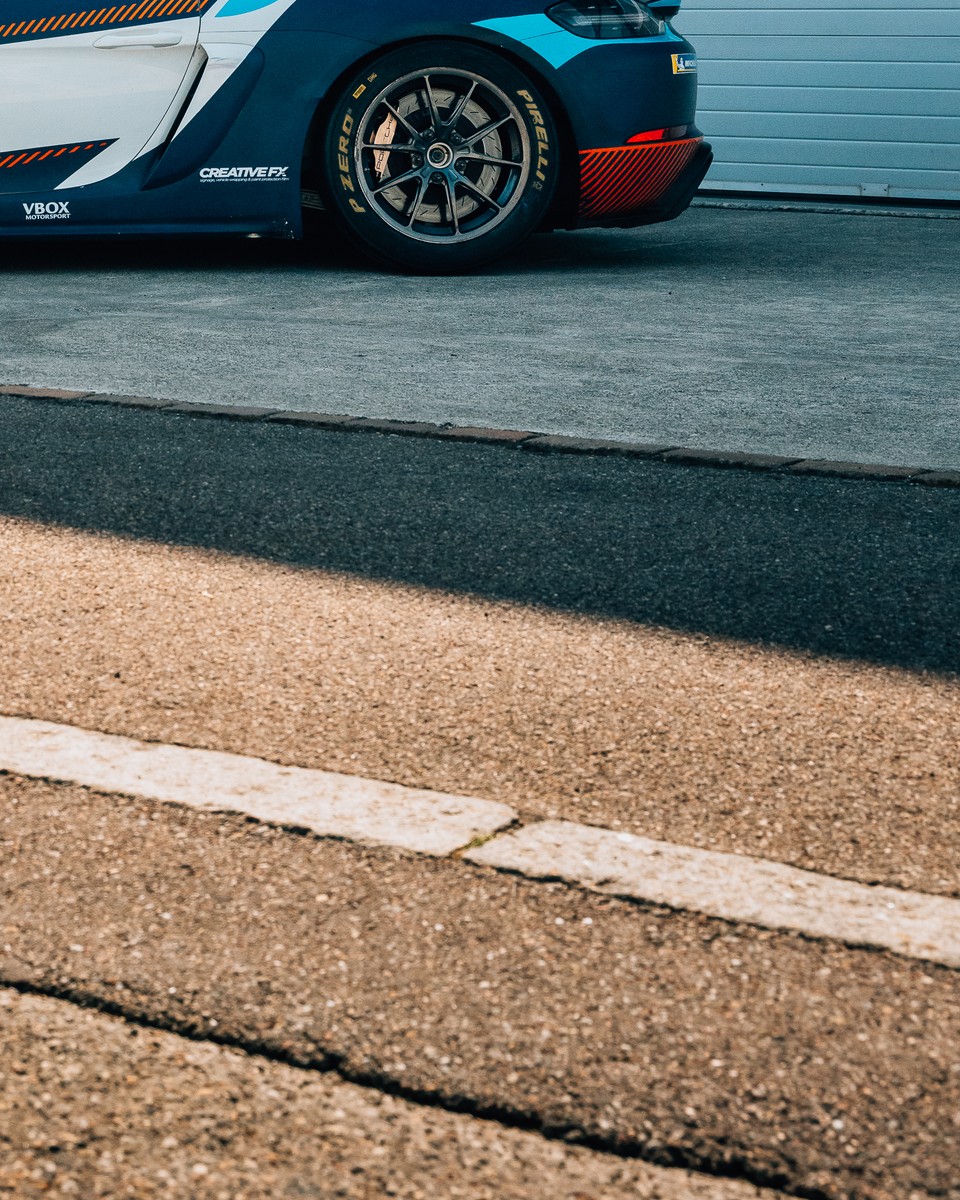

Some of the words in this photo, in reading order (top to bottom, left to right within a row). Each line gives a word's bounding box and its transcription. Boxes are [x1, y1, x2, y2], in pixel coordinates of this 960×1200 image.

[516, 89, 549, 182] PIRELLI
[338, 113, 354, 193] ZERO
[199, 166, 268, 178] CREATIVE
[22, 201, 70, 215] VBOX
[348, 198, 366, 213] P
